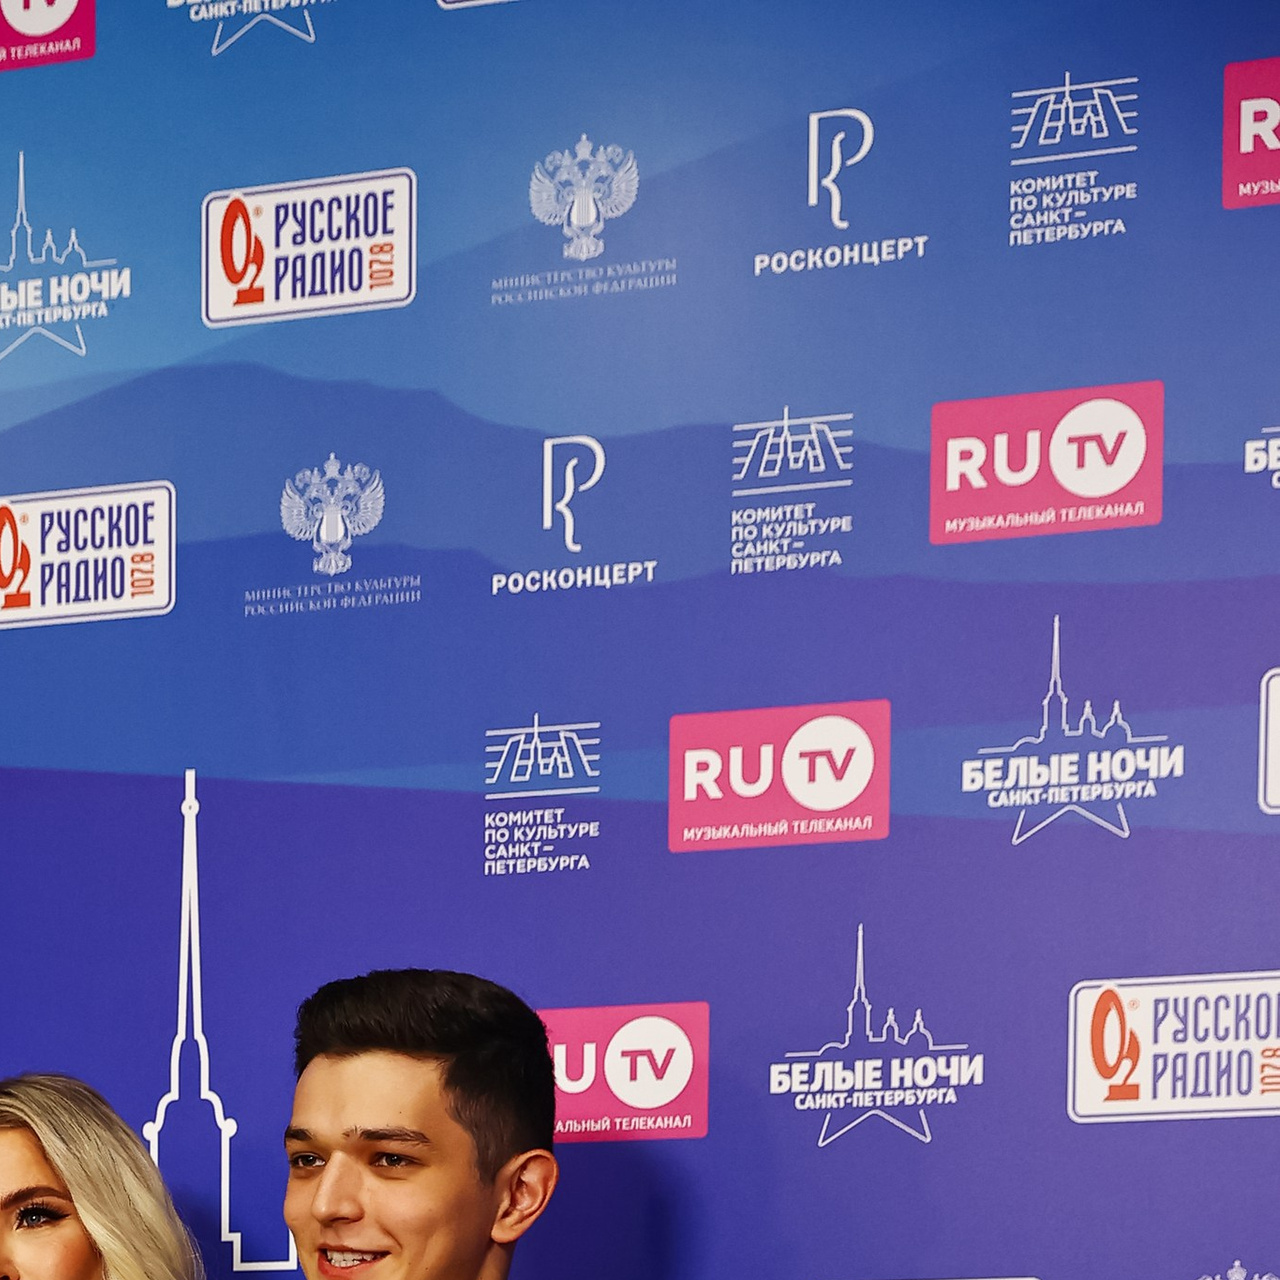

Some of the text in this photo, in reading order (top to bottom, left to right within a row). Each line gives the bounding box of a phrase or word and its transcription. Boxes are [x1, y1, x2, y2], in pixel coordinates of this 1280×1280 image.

[1008, 183, 1138, 214] ПО КУЛЬТУРЕ
[1009, 170, 1099, 197] КОМИТЕТ
[274, 189, 395, 249] РУССКОЕ
[1008, 218, 1127, 247] ПЕТЕРБУРГА
[754, 235, 929, 275] РОСКОНЦЕРТ
[49, 267, 130, 307] НОЧИ
[274, 246, 363, 302] РАДИО
[39, 500, 155, 555] РУССКОЕ
[945, 499, 1145, 532] МУЗЫКАЛЬНЫЙ ТЕЛЕКАНАЛ
[40, 555, 125, 607] РАДИО
[491, 560, 658, 595] РОСКОНЦЕРТ
[961, 745, 1184, 793] БЕЛЫЕ НОЧИ
[988, 780, 1157, 809] САНКТ-ПЕТЕРБУРГА
[483, 822, 600, 845] ПО КУЛЬТУРЕ
[484, 808, 565, 828] КОМИТЕТ
[682, 815, 873, 842] МУЗЫКАЛЬНЫЙ ТЕЛЕКАНАЛ
[483, 854, 591, 876] ПЕТЕРБУРГА
[768, 1053, 983, 1095] БЕЛЫЕ НОЧИ
[794, 1086, 957, 1111] САНКТ-ПЕТЕРБУРГА
